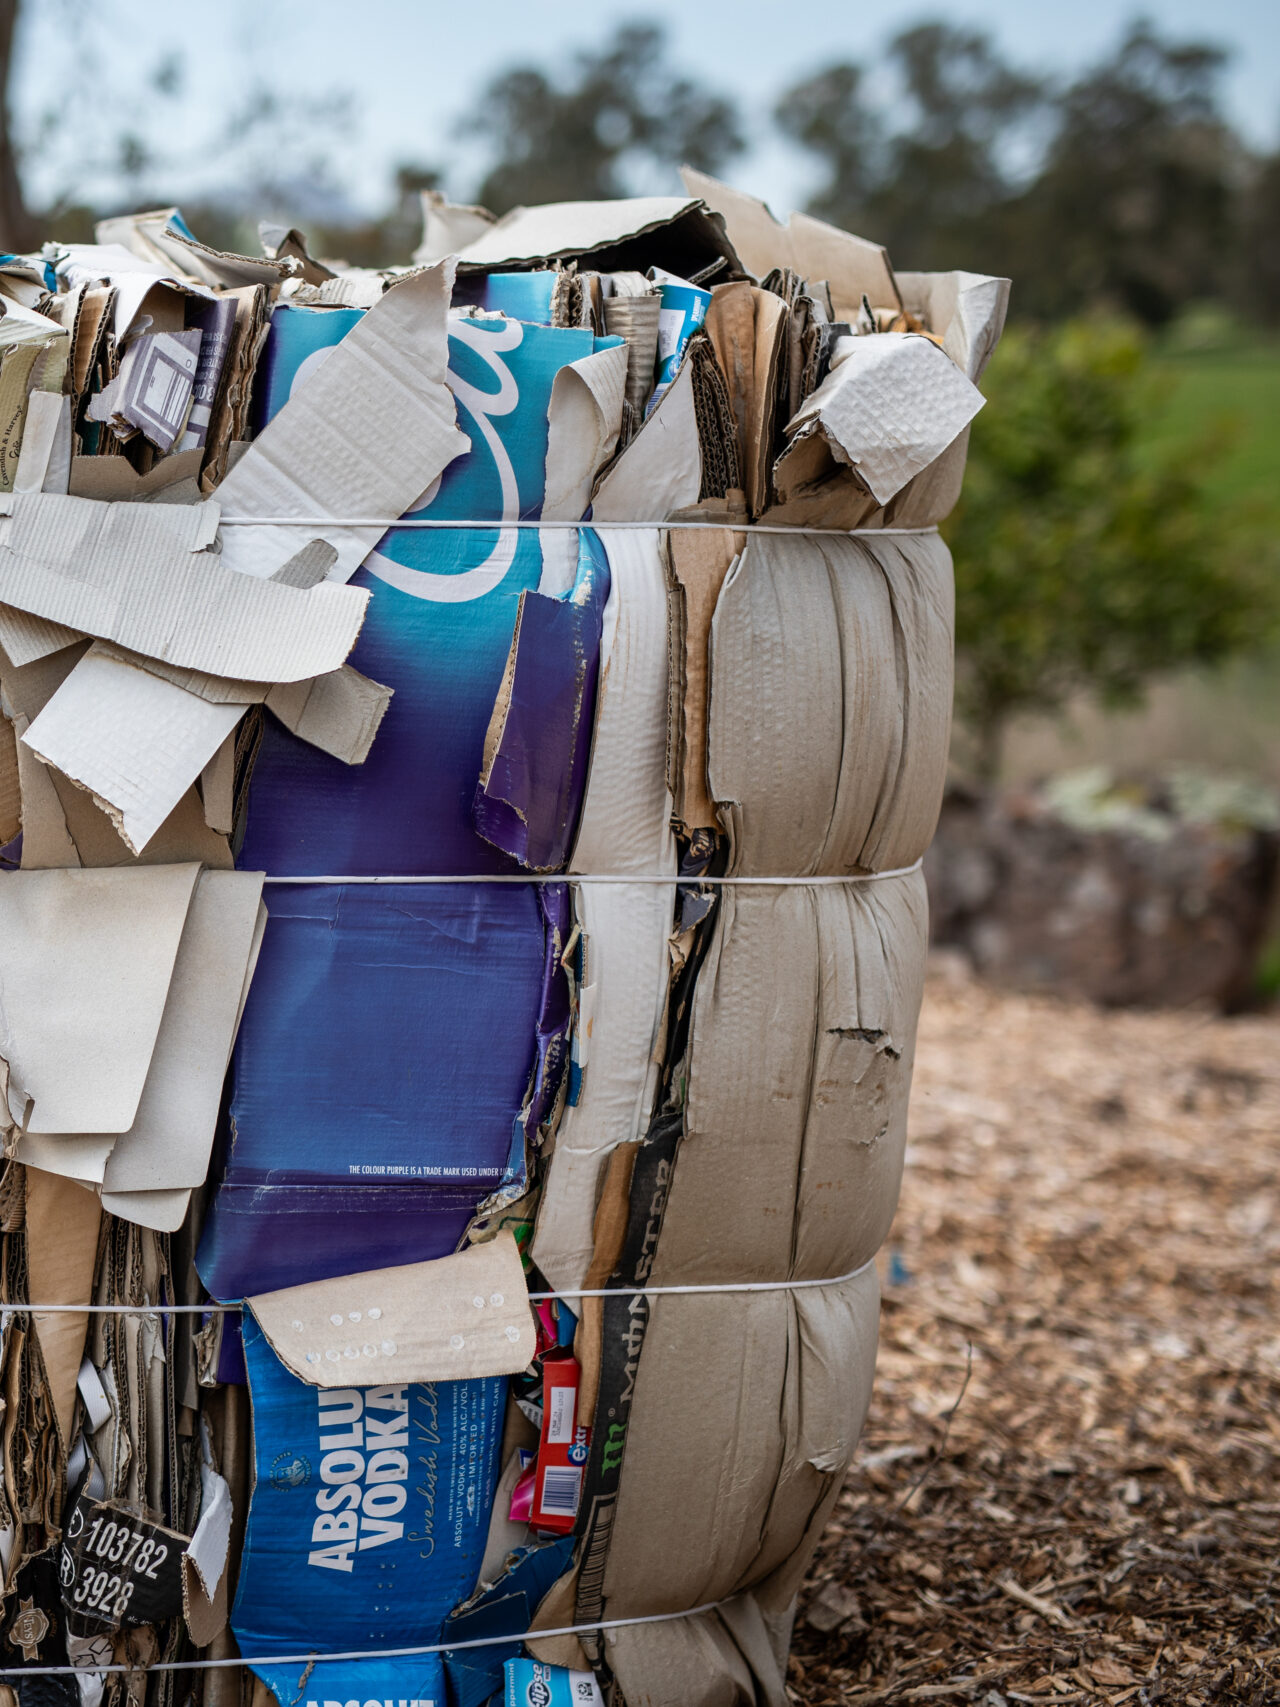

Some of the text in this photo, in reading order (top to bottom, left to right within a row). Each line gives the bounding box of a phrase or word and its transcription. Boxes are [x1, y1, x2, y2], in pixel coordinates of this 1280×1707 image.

[349, 1165, 360, 1174] THE
[361, 1166, 386, 1175] COLOUR
[387, 1166, 409, 1175] PURPLE
[410, 1166, 417, 1175] IS
[417, 1166, 423, 1175] A
[423, 1166, 442, 1176] TRADE
[443, 1167, 460, 1176] MARK
[461, 1167, 477, 1176] USED
[478, 1167, 499, 1176] UNDER
[490, 1412, 498, 1435] WITH
[572, 1426, 587, 1461] extr
[459, 1435, 467, 1456] 40%
[308, 1386, 366, 1573] ABSOLU
[358, 1385, 410, 1551] VODKA
[407, 1382, 441, 1558] Swedish Vodk
[457, 1463, 466, 1498] VODKA
[85, 1517, 168, 1579] 103782
[74, 1567, 134, 1617] 3928
